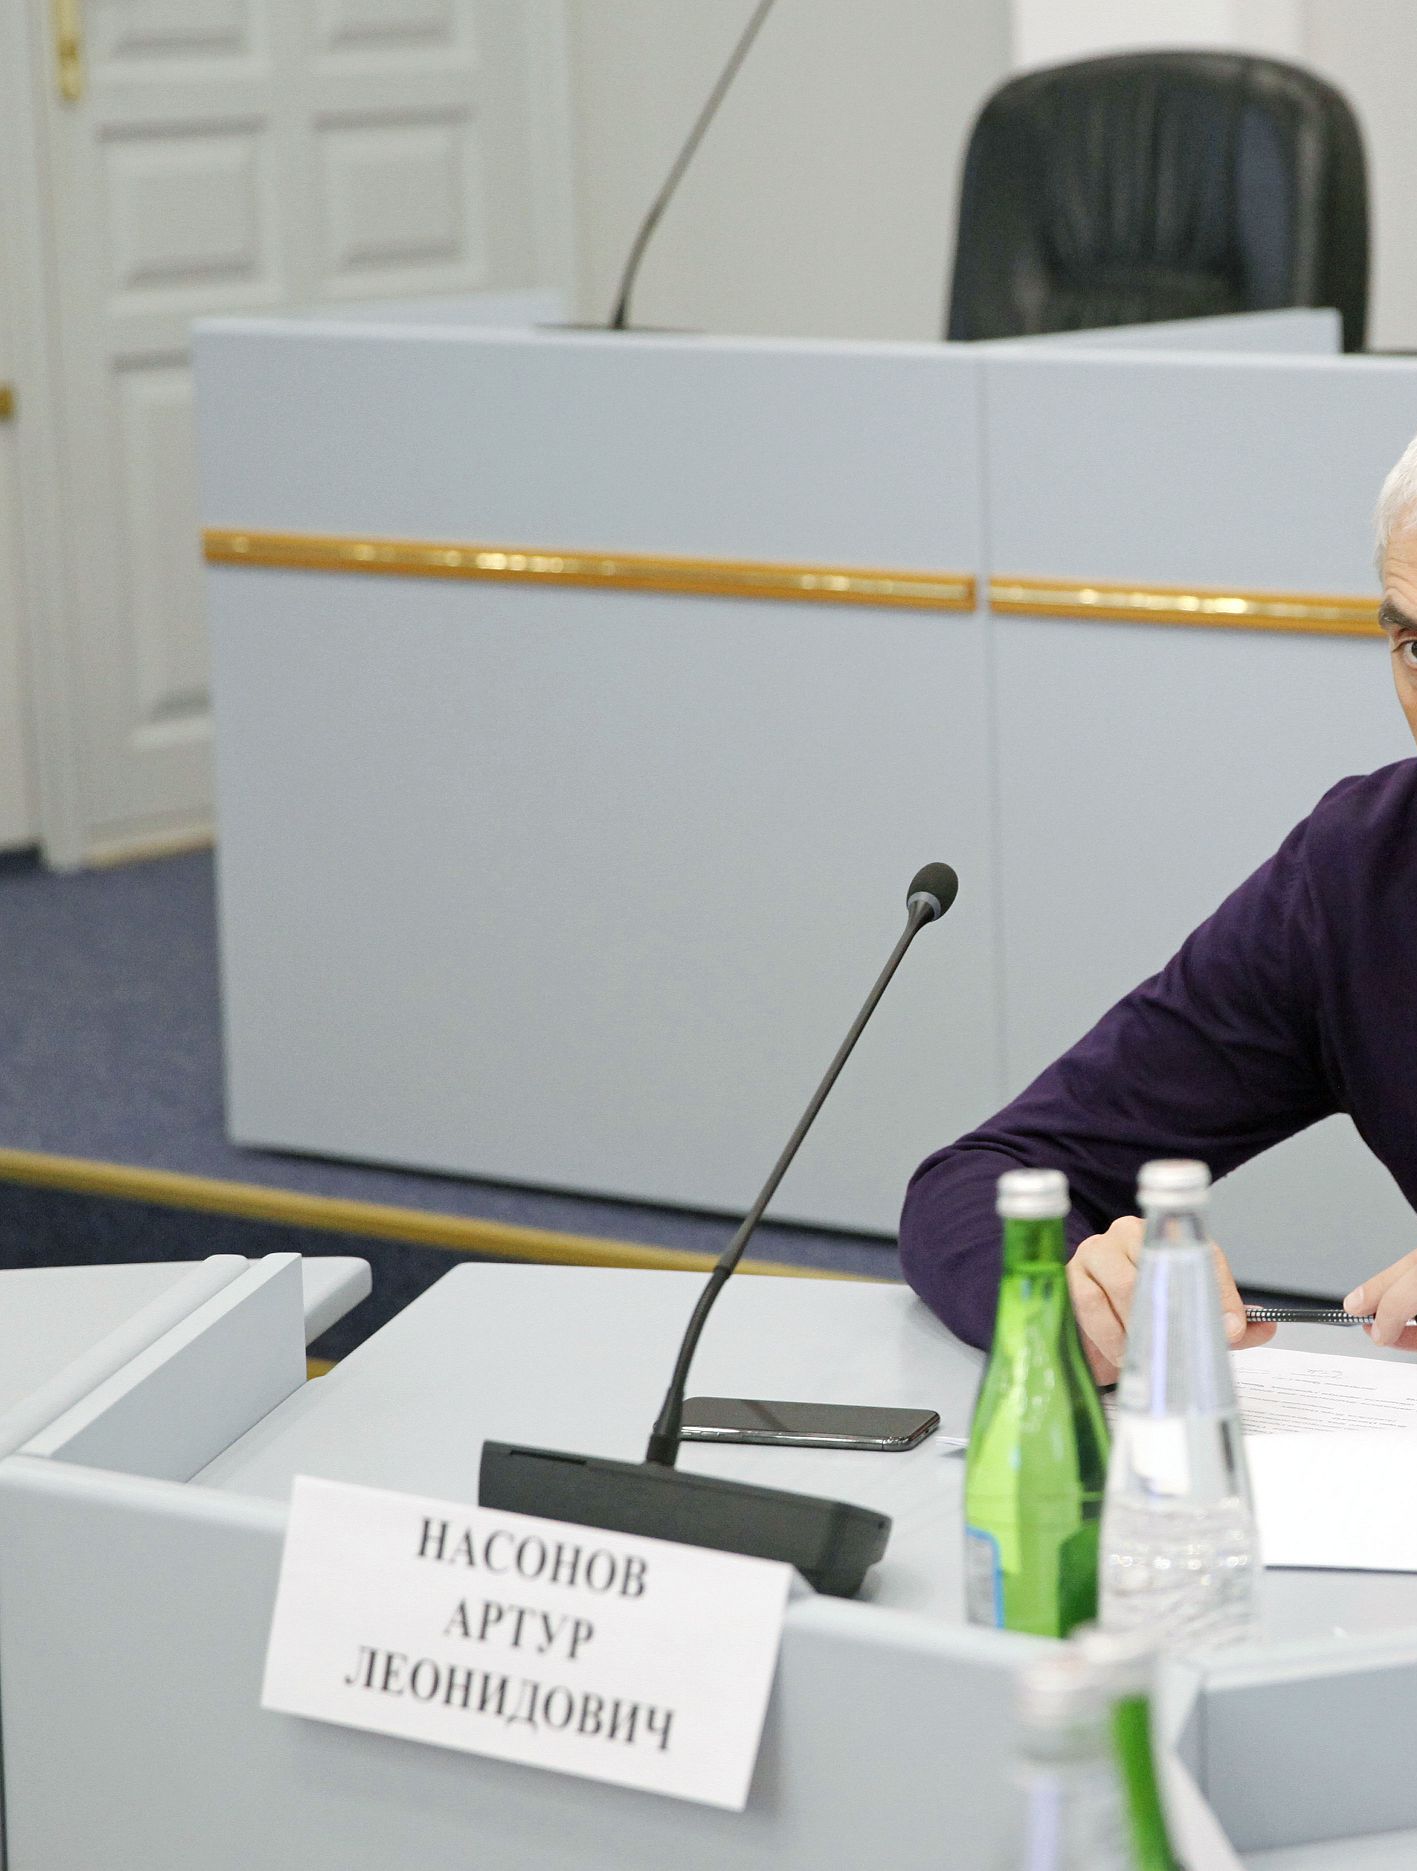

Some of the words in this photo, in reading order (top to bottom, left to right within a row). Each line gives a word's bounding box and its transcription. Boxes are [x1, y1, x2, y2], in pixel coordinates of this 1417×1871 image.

[417, 1517, 649, 1599] НАСОНОВ
[444, 1598, 595, 1660] АРТУР
[344, 1645, 676, 1751] ЛЕОНИДОВИЧ
